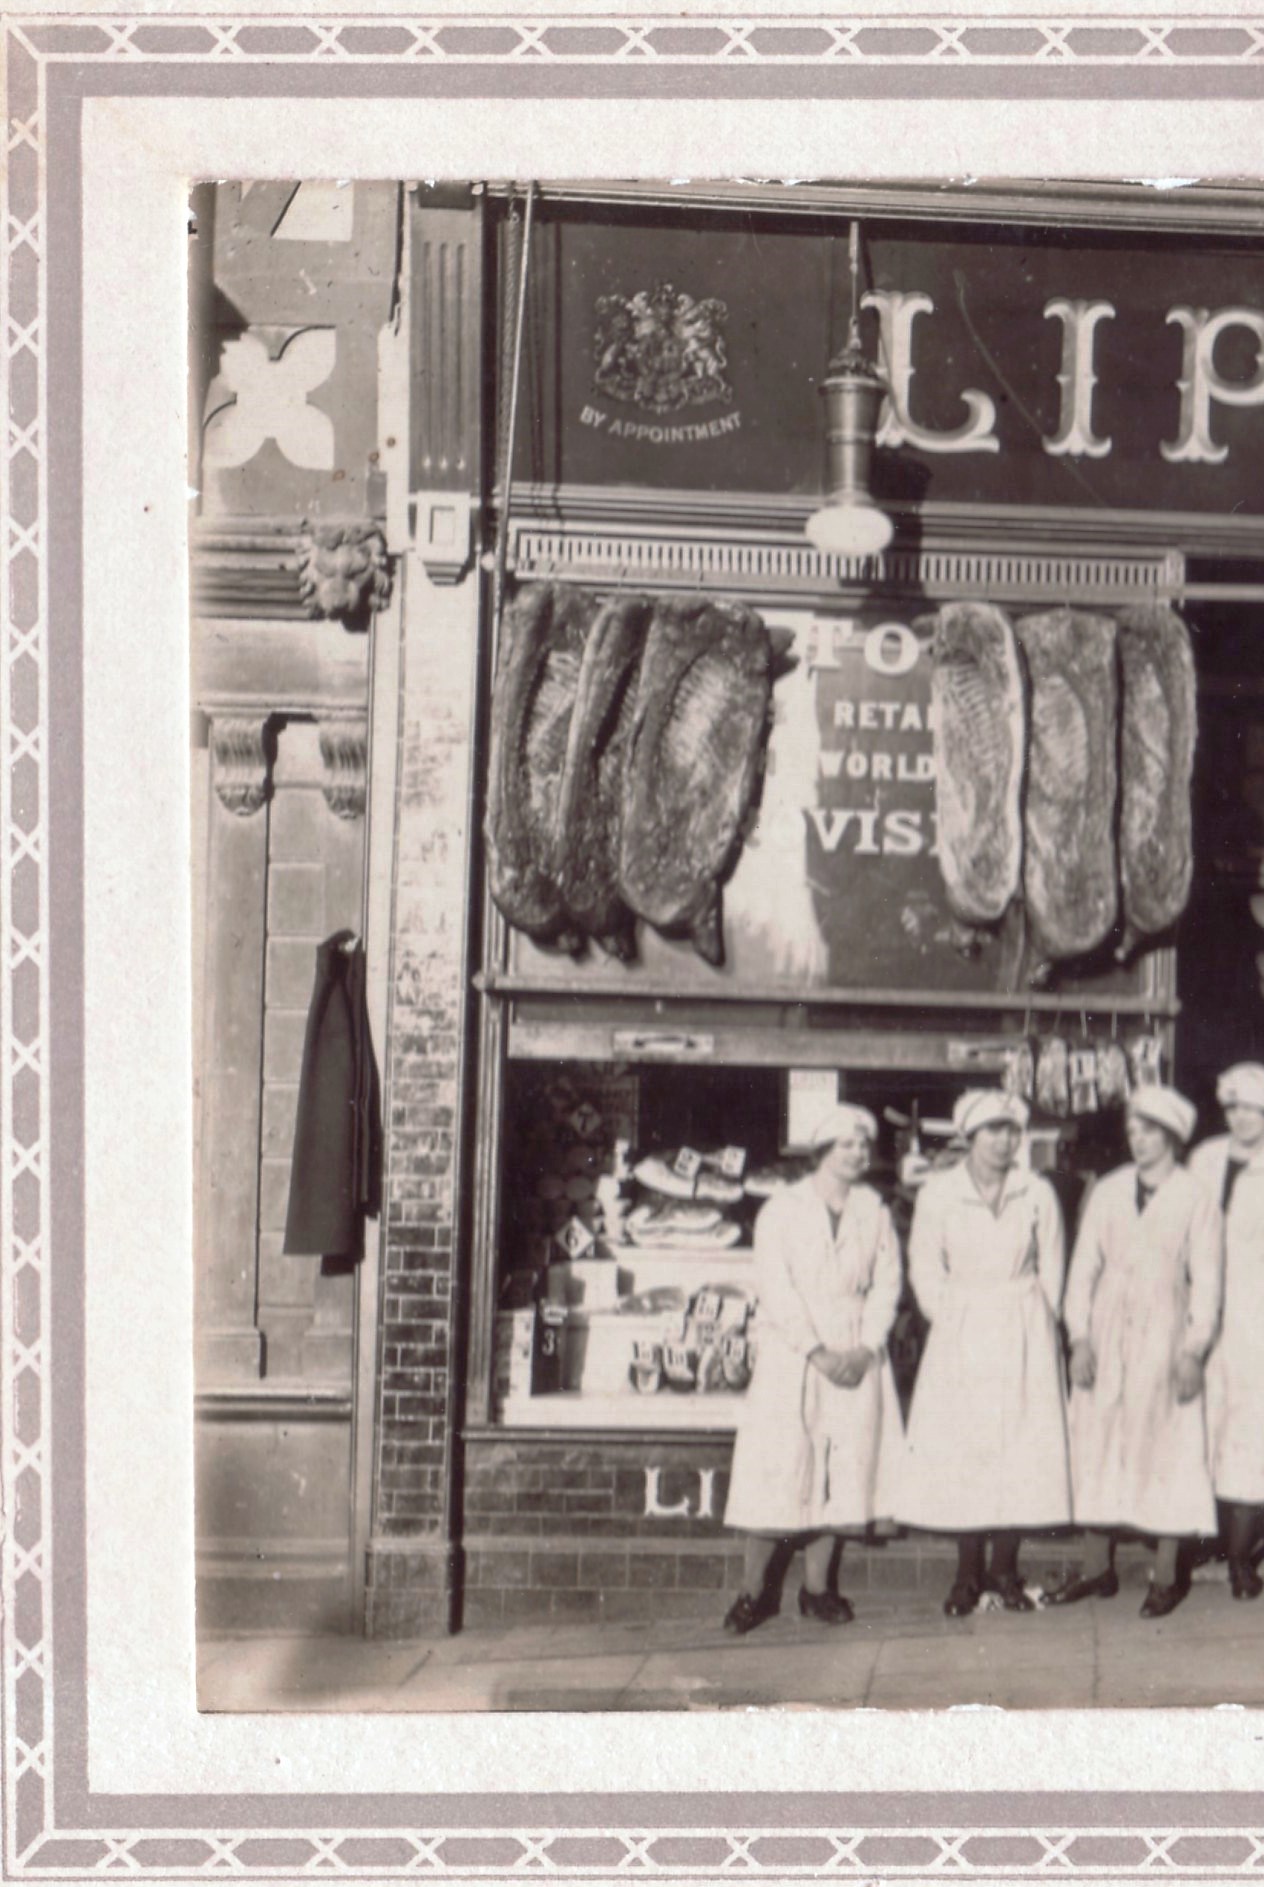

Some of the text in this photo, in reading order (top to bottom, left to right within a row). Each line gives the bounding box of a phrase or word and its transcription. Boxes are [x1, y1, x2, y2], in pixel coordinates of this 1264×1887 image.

[579, 405, 741, 443] BY APPOINTMENT
[818, 752, 936, 782] WORLD
